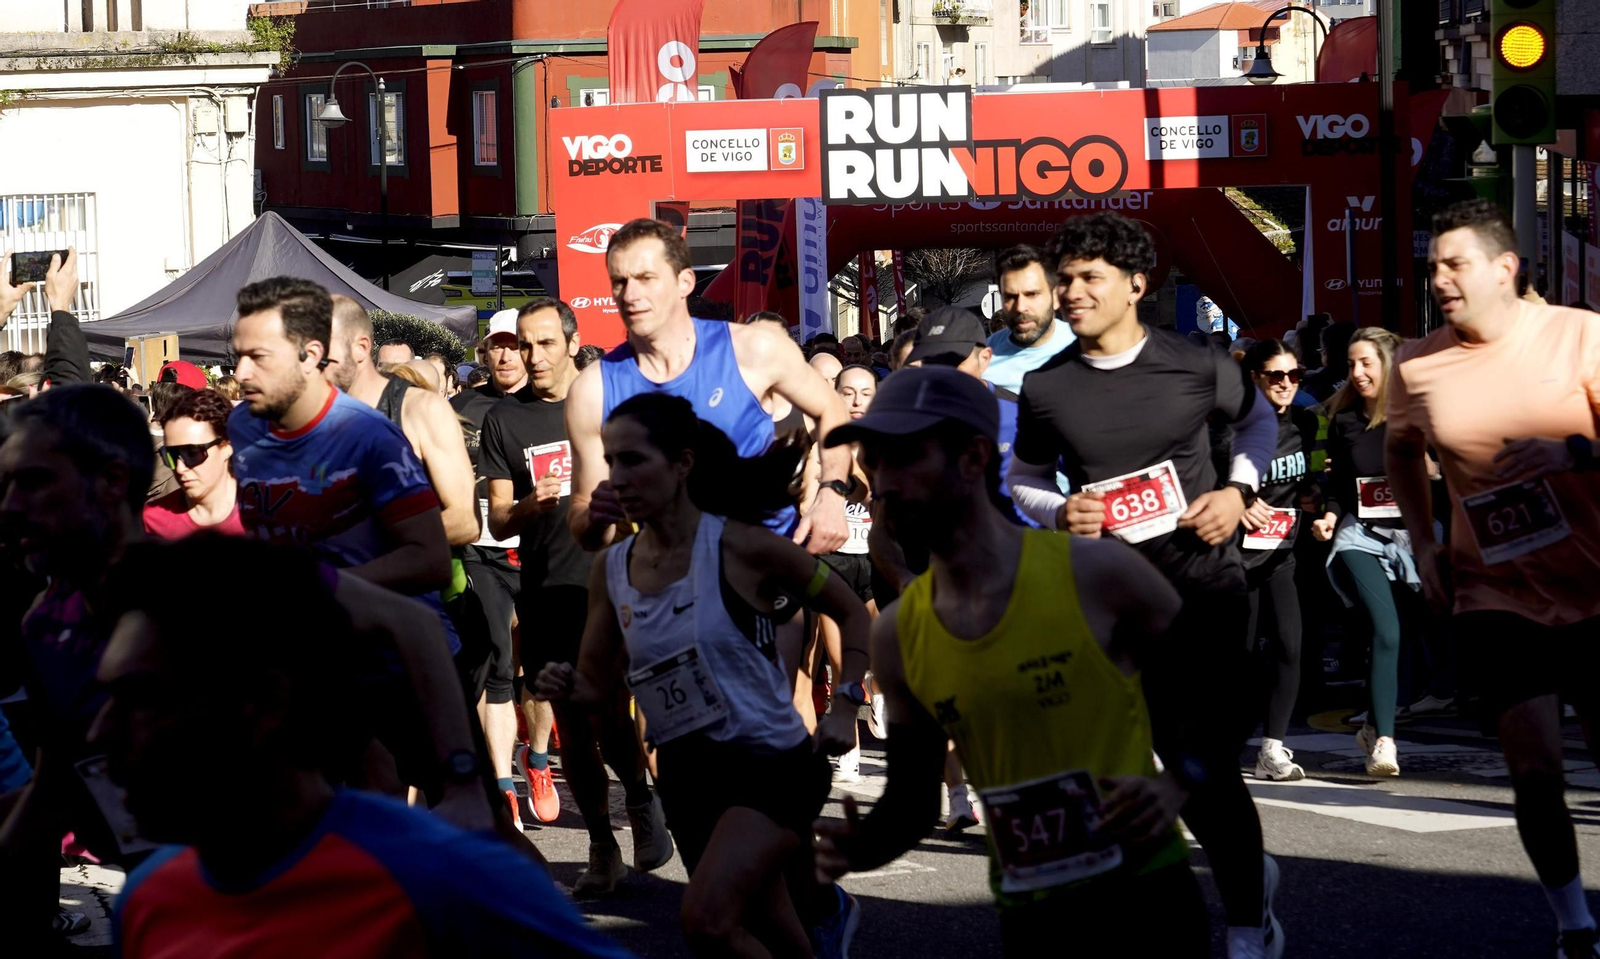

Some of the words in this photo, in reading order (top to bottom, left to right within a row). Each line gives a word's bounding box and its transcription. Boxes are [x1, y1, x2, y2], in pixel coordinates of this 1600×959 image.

[827, 92, 967, 145] RUN
[1150, 124, 1222, 137] CONCELLO
[1295, 113, 1370, 140] VIGO
[562, 133, 633, 160] VIGO
[692, 138, 760, 150] CONCELLO
[701, 152, 717, 163] DE
[721, 151, 753, 162] VIGO
[1160, 139, 1178, 151] DE
[1182, 138, 1214, 149] VIGO
[568, 155, 663, 177] DEPORTE
[1111, 489, 1160, 521] 638
[1487, 503, 1533, 536] 621
[656, 680, 687, 710] 26
[1011, 807, 1066, 853] 547
